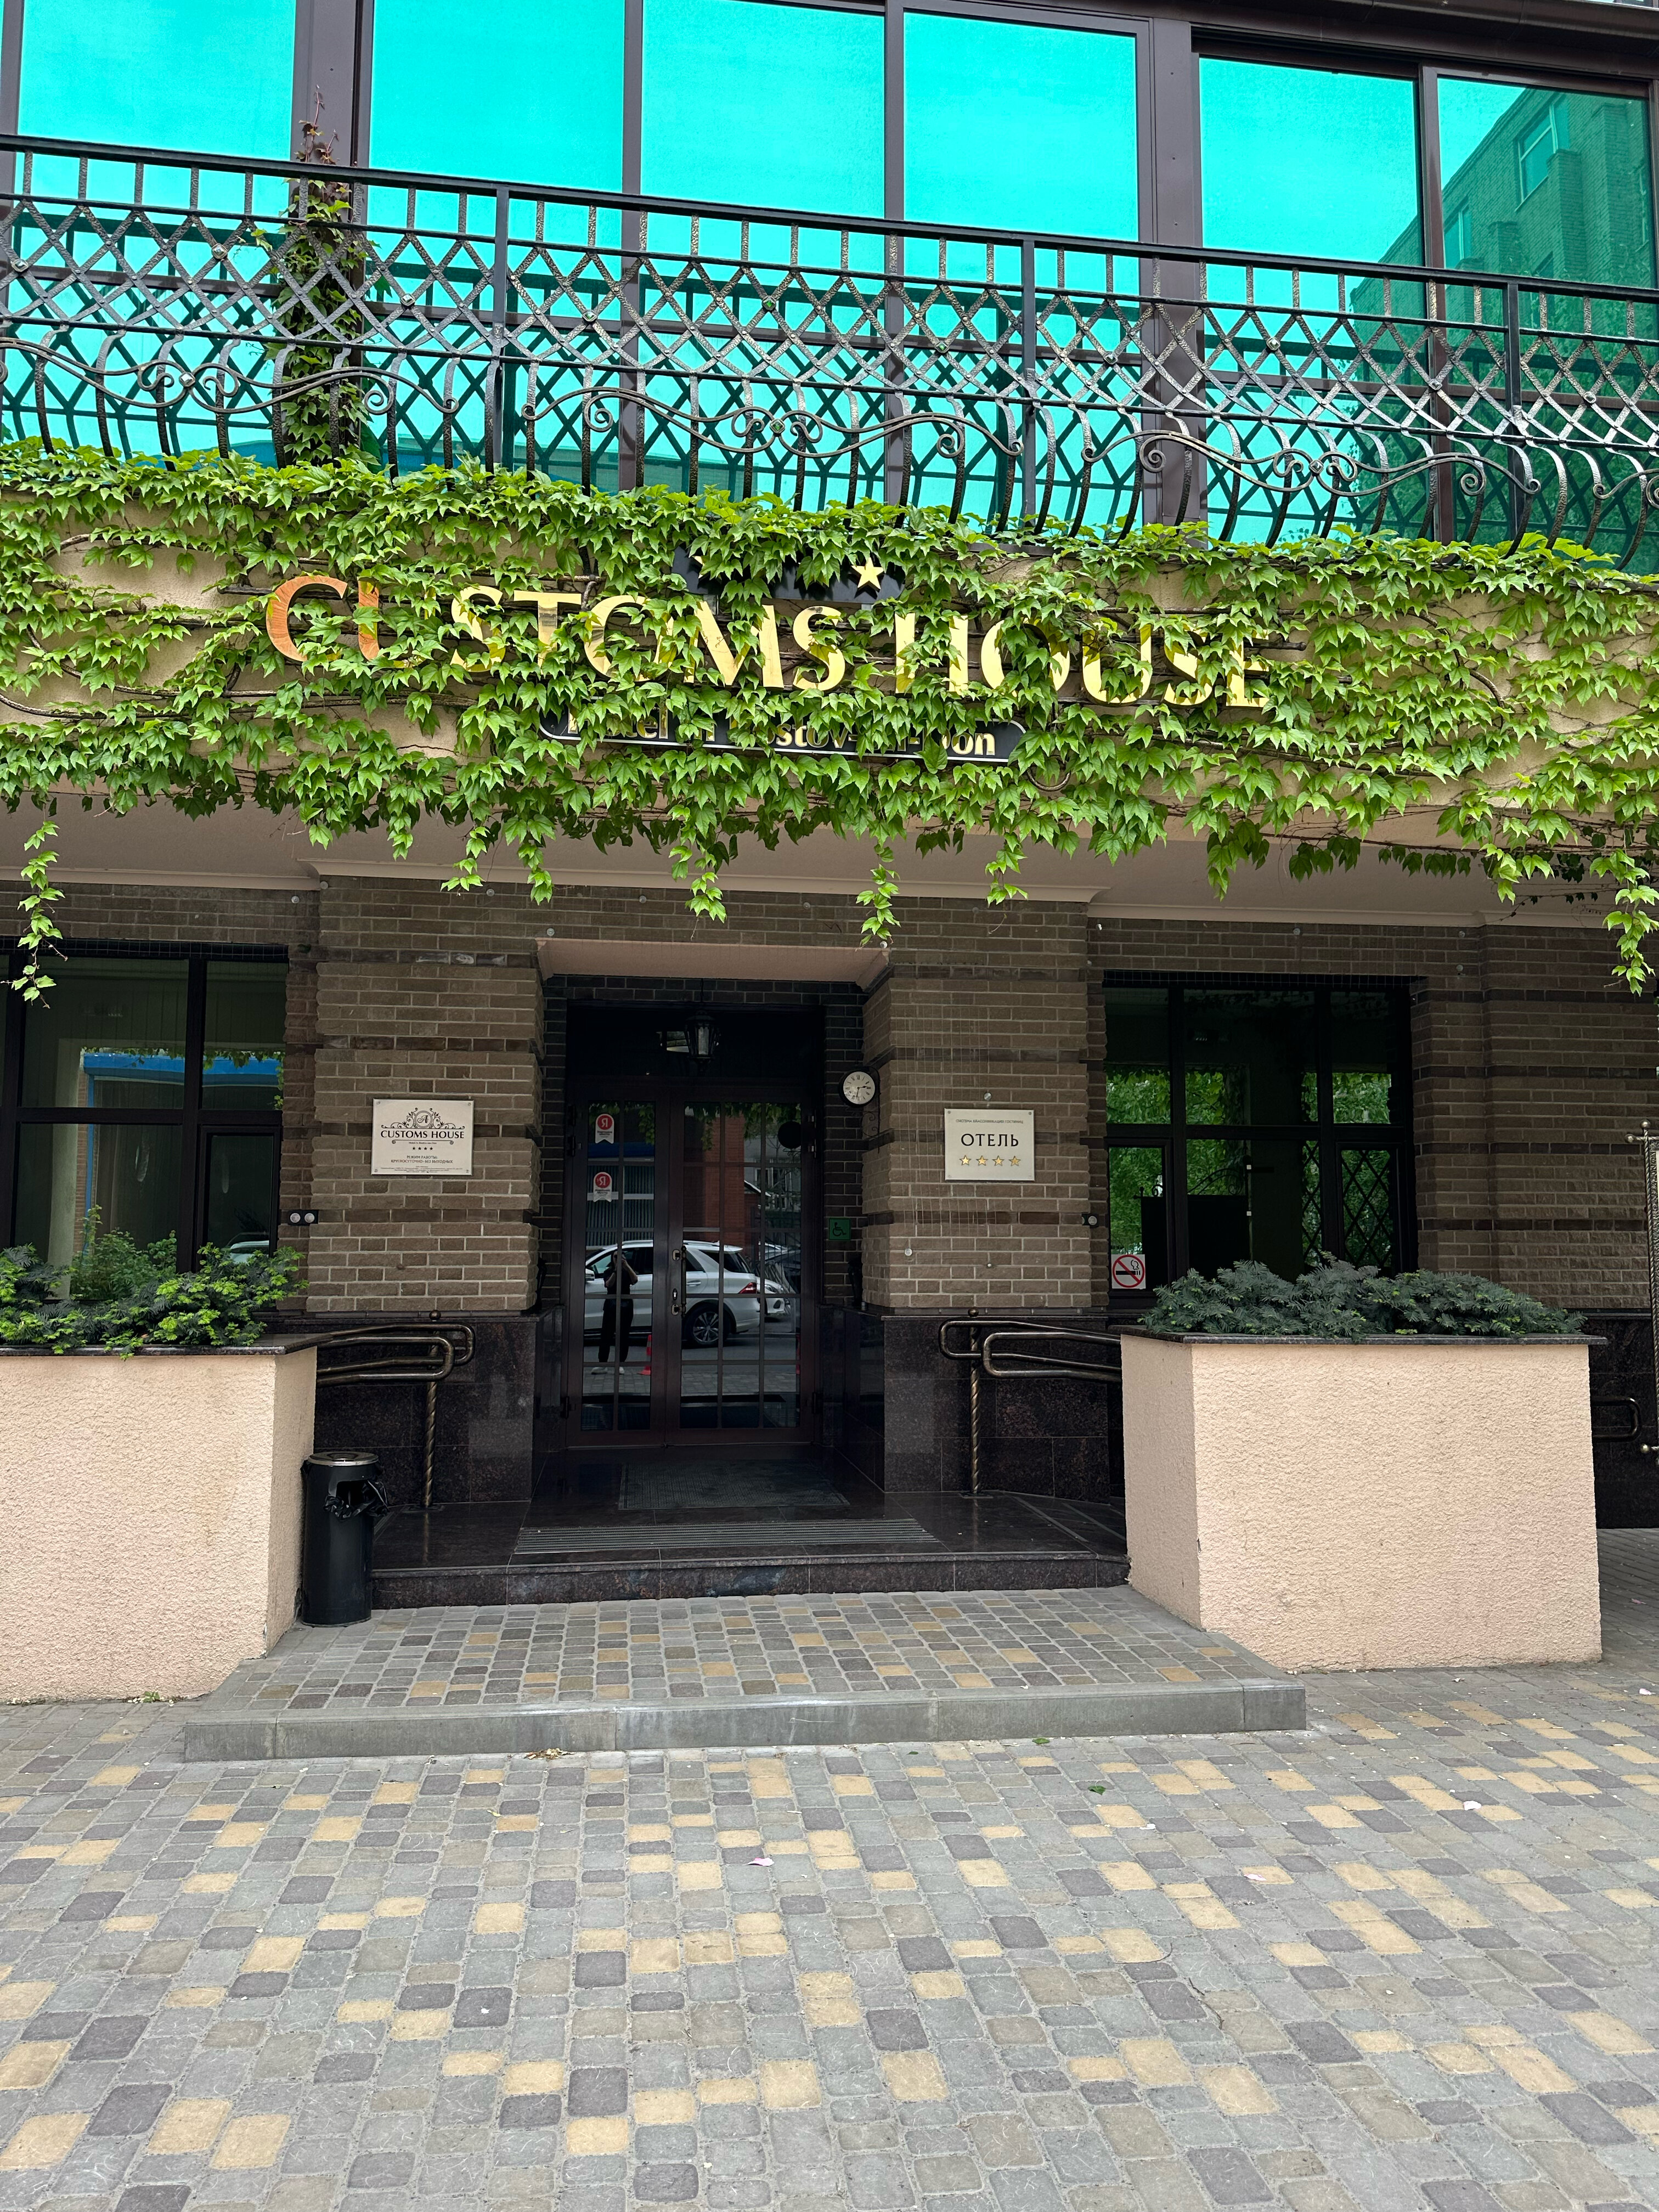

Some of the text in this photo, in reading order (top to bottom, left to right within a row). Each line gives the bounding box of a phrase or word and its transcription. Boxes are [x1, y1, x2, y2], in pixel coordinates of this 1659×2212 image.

[380, 1130, 465, 1139] CUSTOMS HOUSE
[961, 1133, 1019, 1147] ОТЕЛЬ
